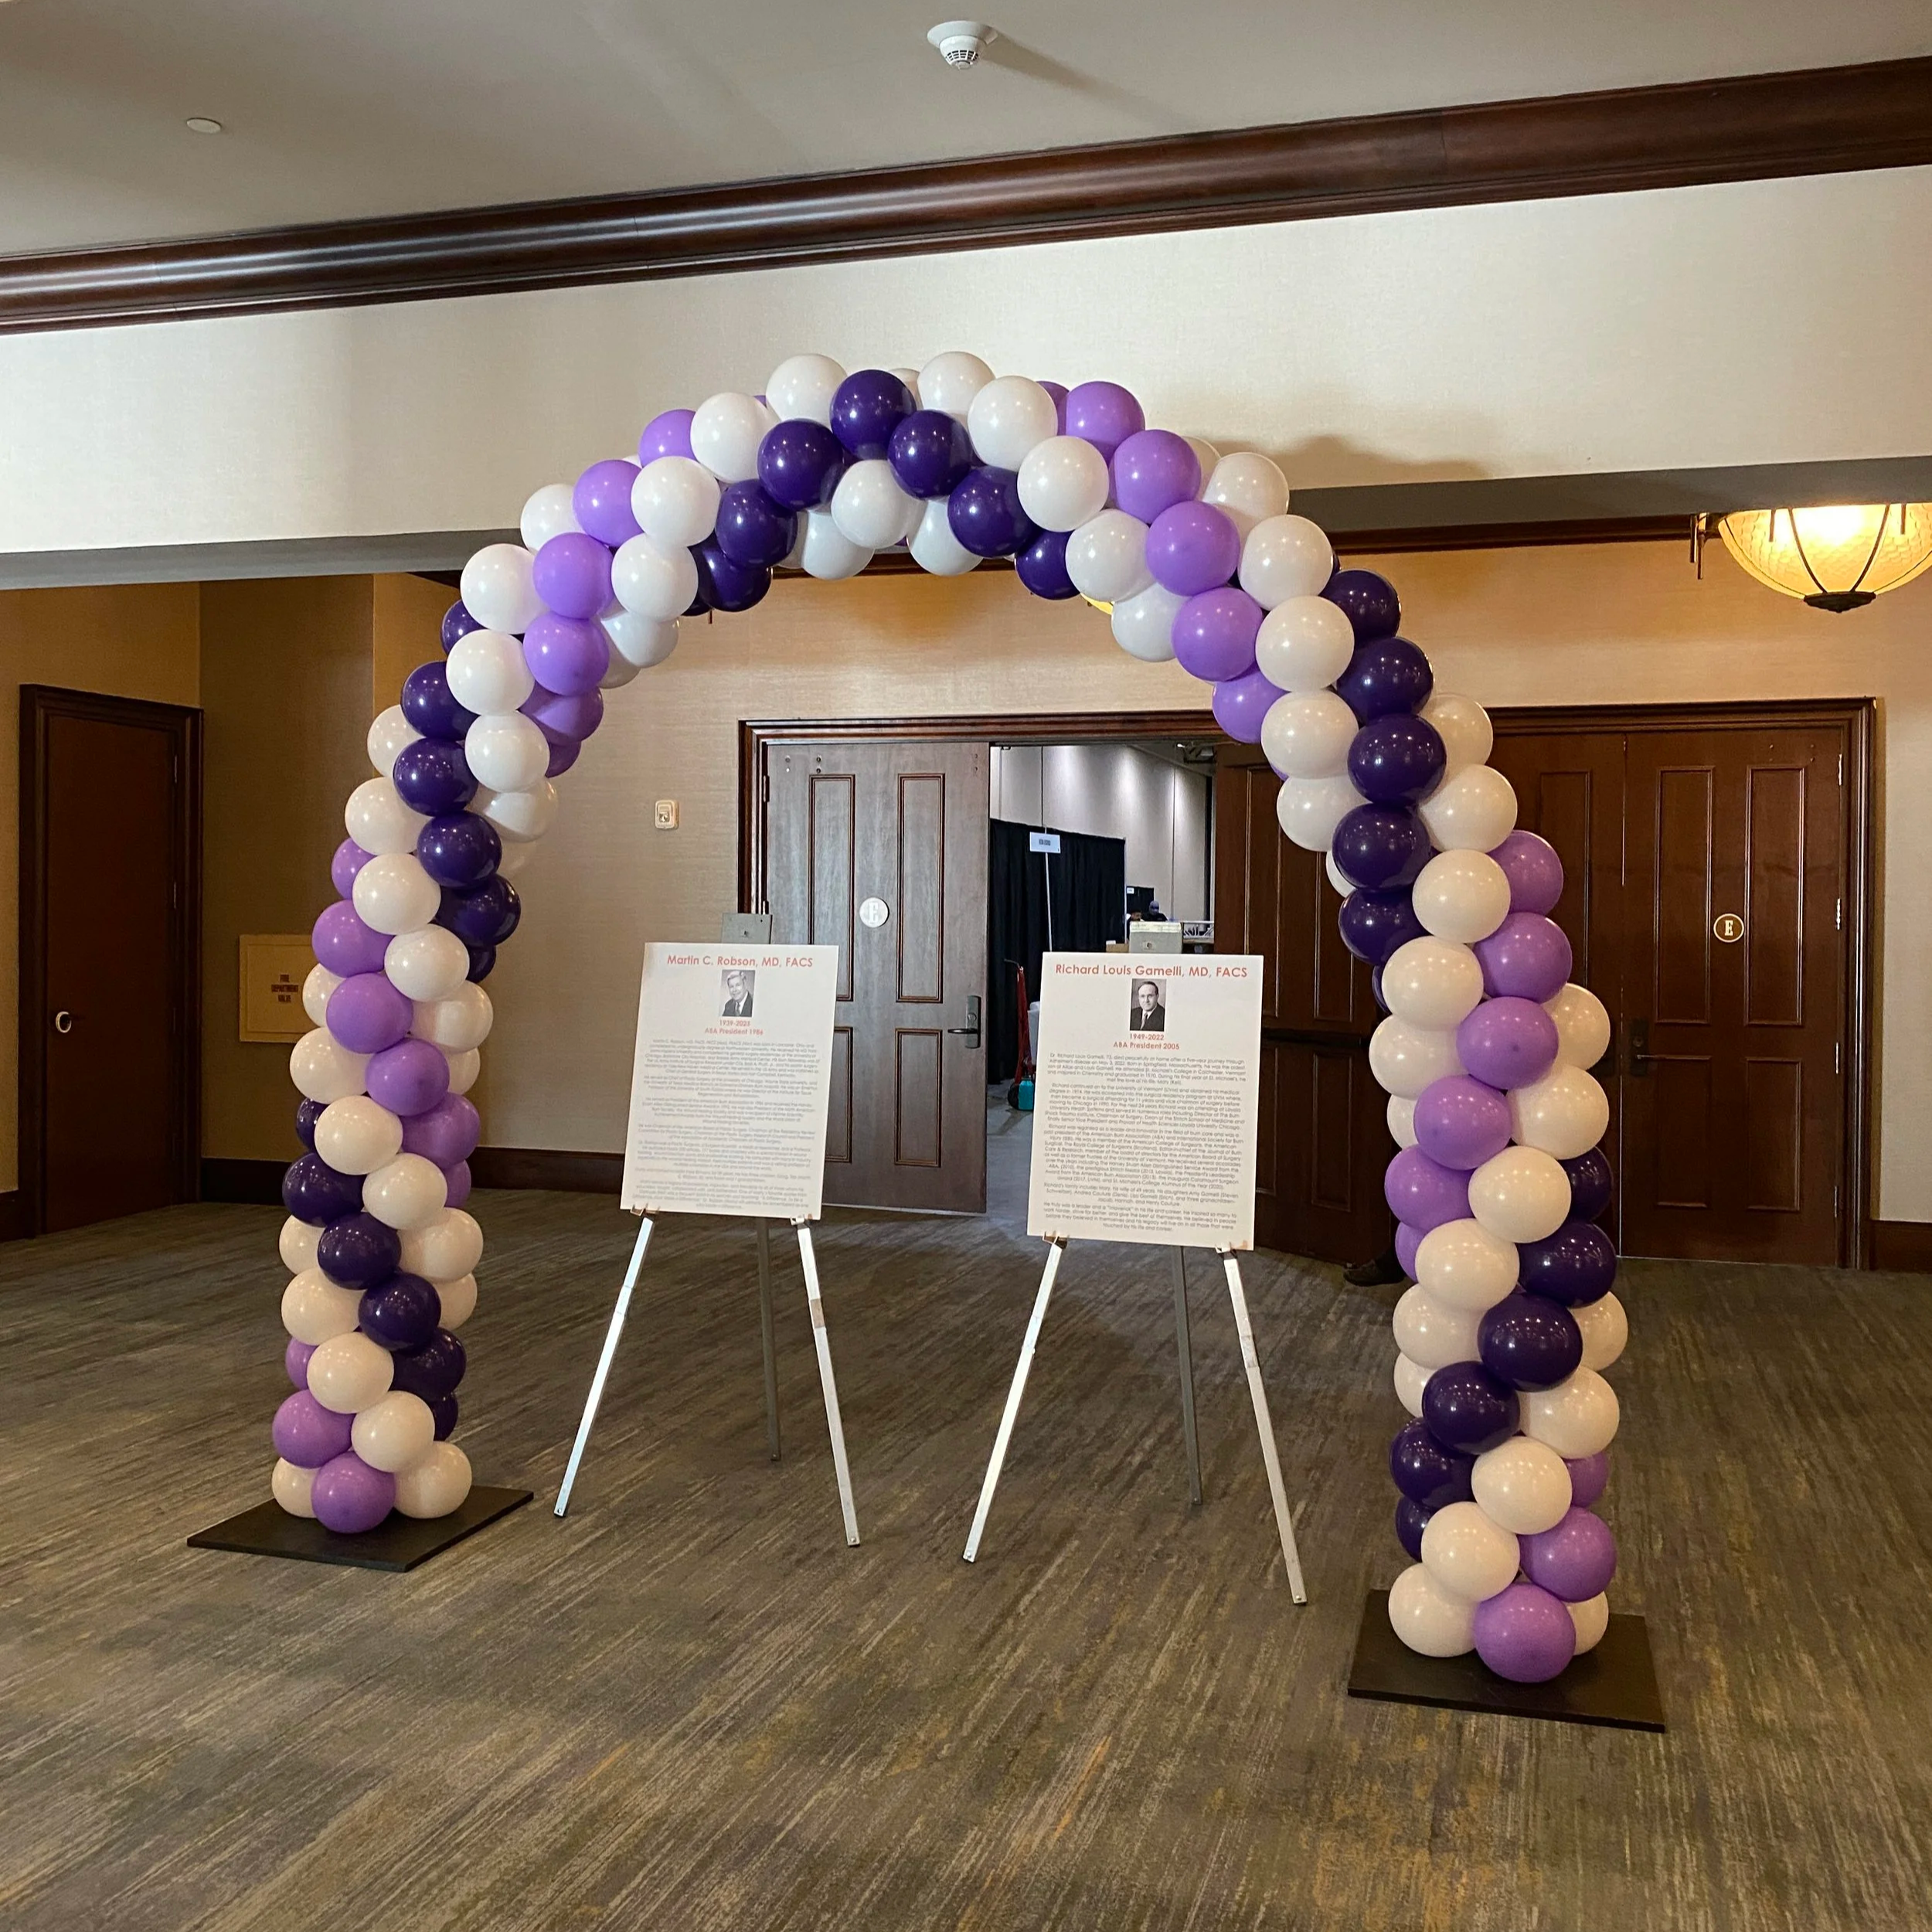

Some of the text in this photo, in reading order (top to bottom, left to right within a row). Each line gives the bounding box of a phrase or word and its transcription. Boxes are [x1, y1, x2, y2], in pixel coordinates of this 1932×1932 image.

[869, 902, 878, 923] E
[1725, 920, 1733, 936] E
[667, 954, 813, 968] Martin C. Robson, MD, FACS
[1055, 964, 1247, 978] Richard Louis Gamelli, MD, FACS
